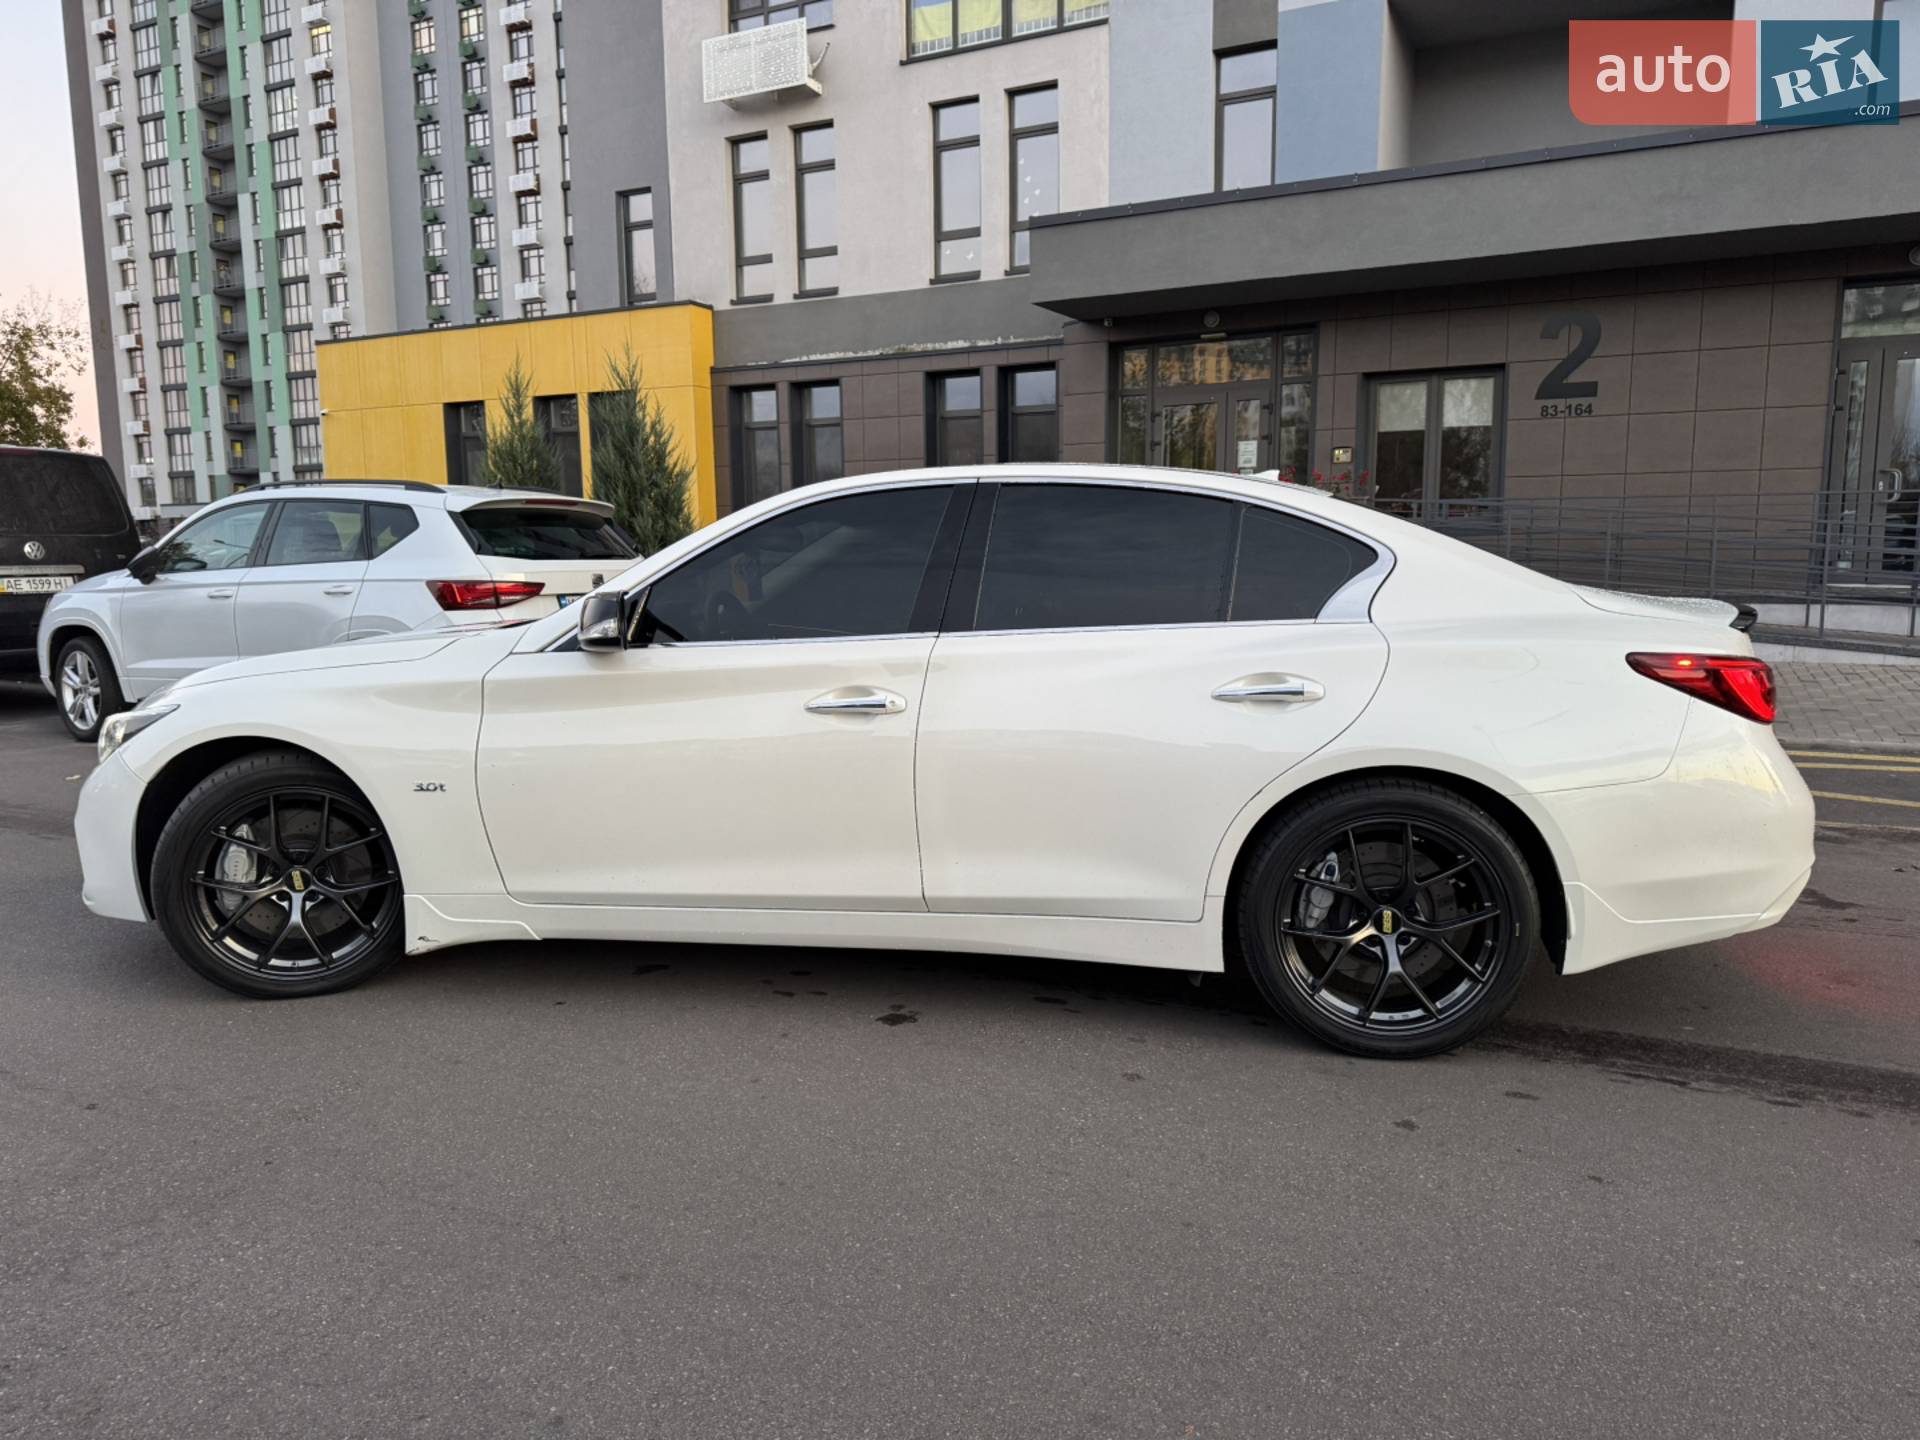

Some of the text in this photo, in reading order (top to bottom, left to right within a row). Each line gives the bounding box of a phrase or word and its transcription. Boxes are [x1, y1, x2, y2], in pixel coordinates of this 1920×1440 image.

[1534, 310, 1602, 400] 2
[1540, 403, 1594, 418] 83-164
[6, 579, 23, 591] AE
[26, 579, 52, 591] 1599
